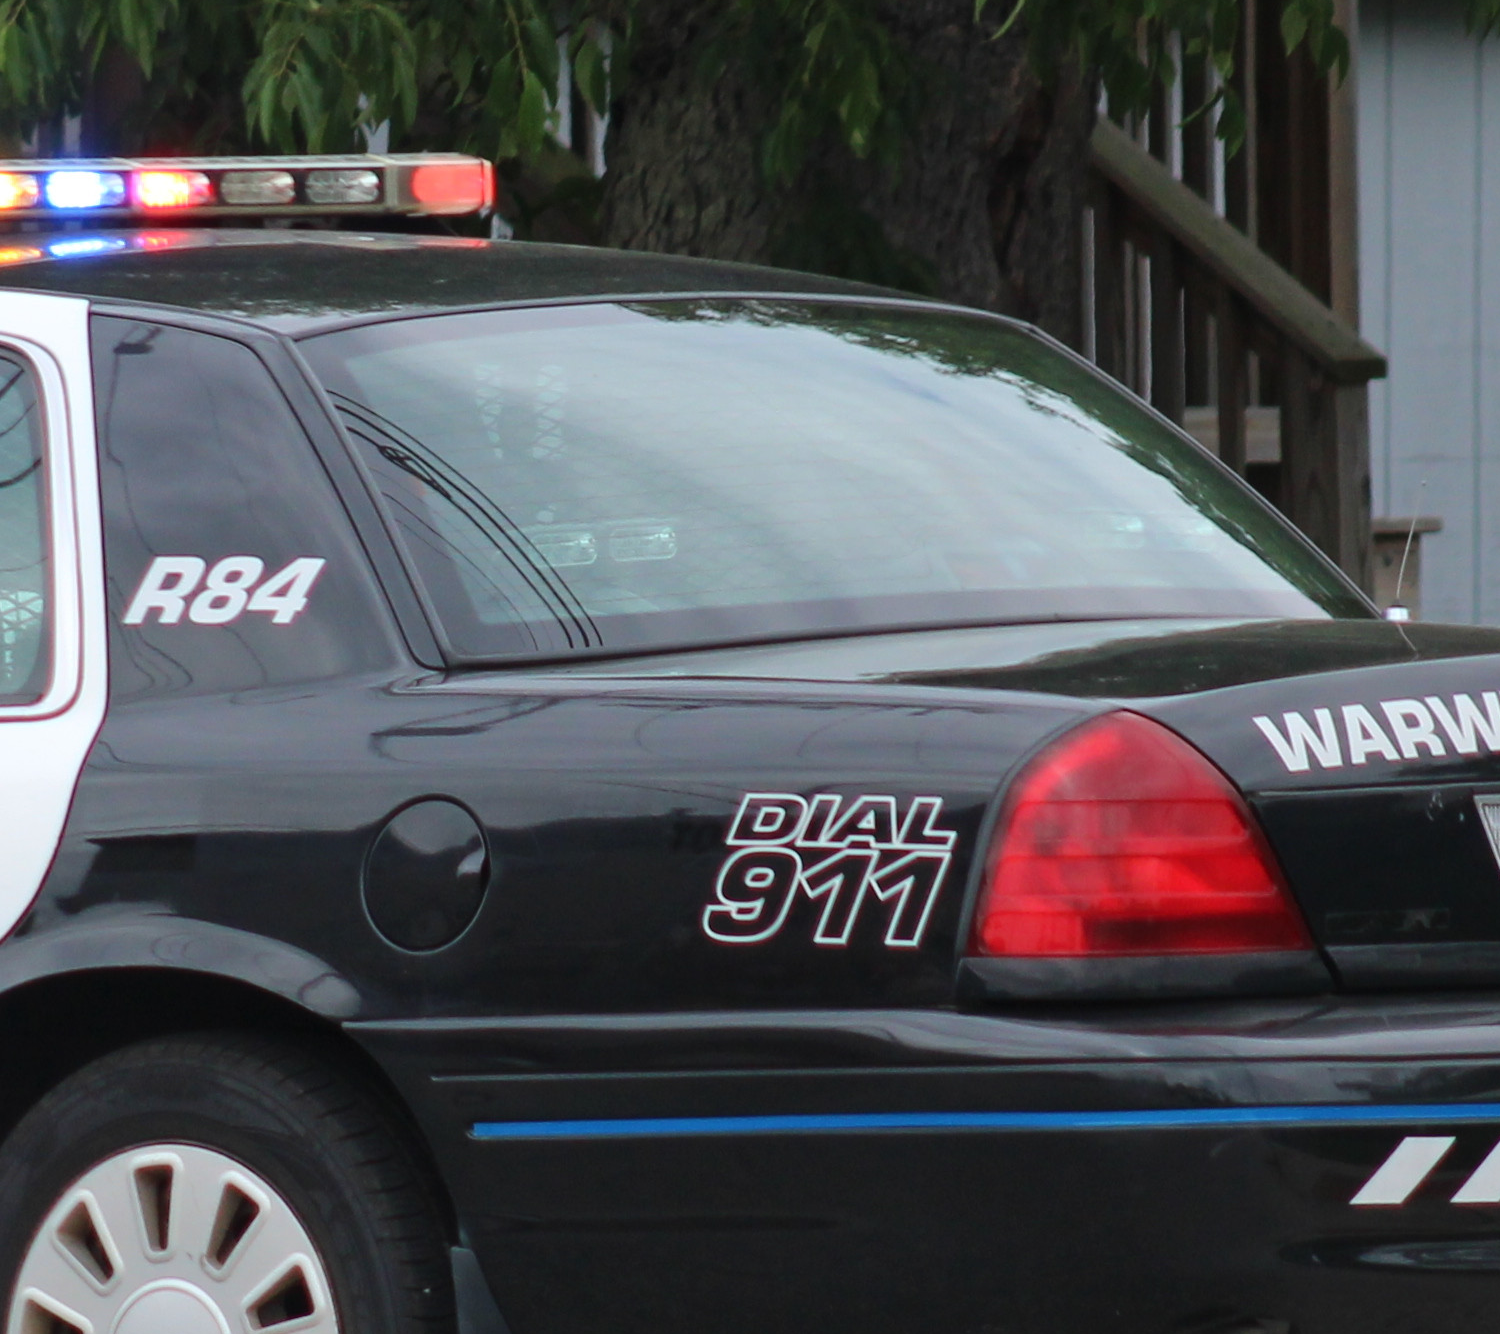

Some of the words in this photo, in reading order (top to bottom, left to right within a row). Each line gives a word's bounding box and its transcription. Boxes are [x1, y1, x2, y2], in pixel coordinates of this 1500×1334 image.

[122, 555, 327, 625] R84
[725, 793, 957, 850] DIAL
[702, 846, 953, 948] 911
